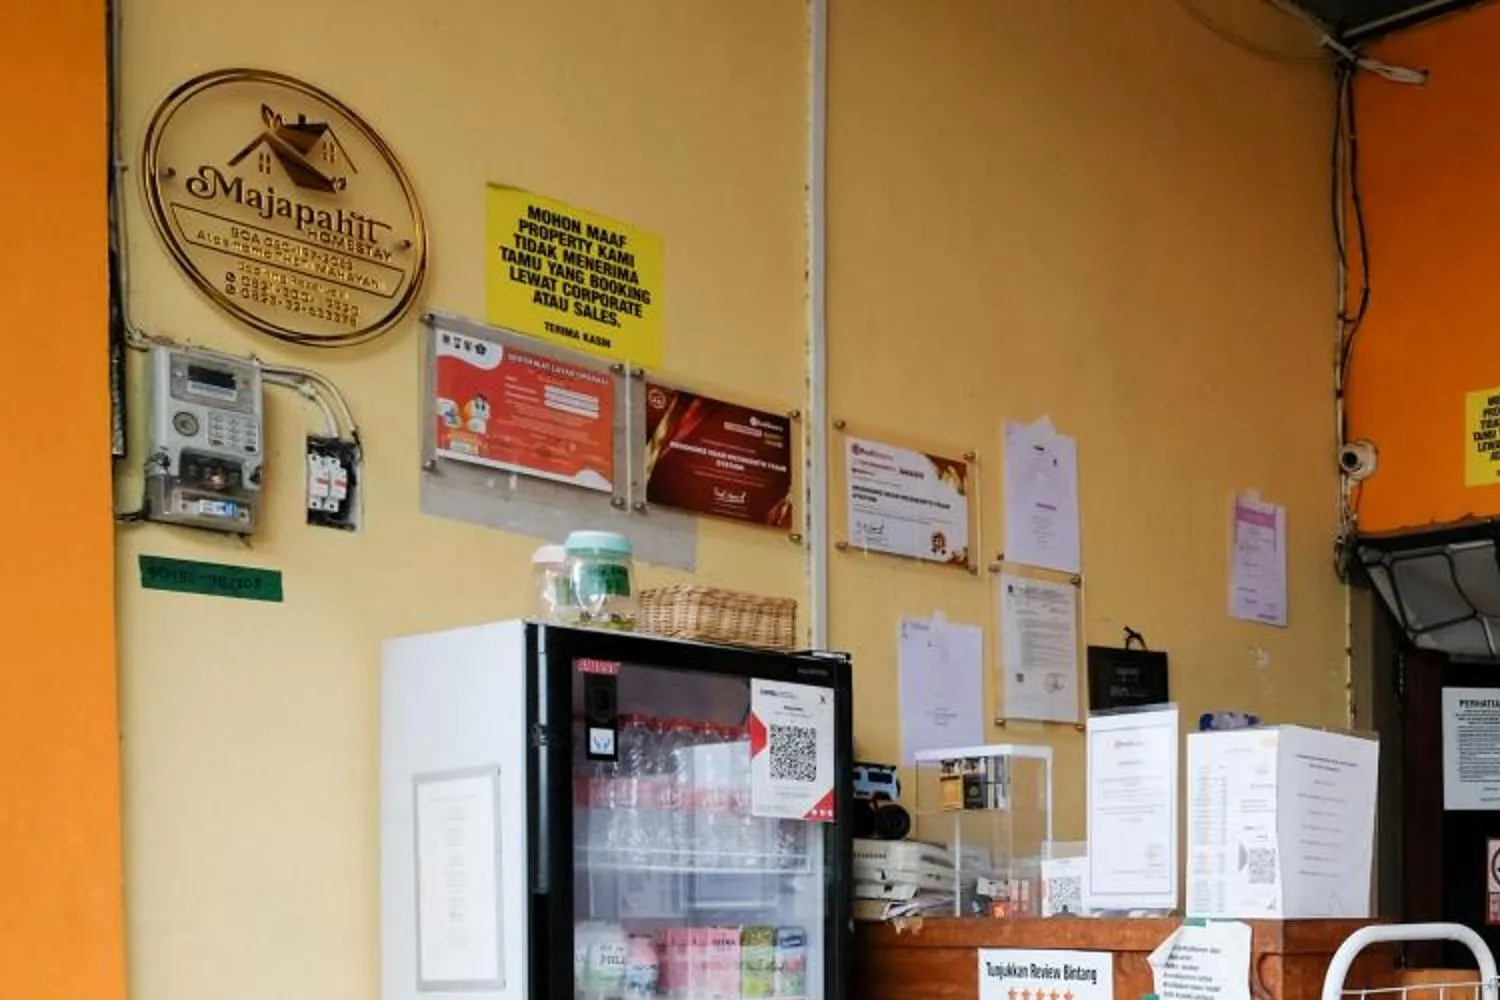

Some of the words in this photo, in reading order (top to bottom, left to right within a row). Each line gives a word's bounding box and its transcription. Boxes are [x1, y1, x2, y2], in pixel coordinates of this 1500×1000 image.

[186, 165, 392, 243] Majapahit
[528, 204, 581, 234] MOHON
[586, 224, 627, 248] MAAF
[307, 228, 393, 262] HOMESTAY
[513, 233, 557, 260] TIDAK
[563, 250, 639, 285] MENERIMA
[519, 218, 592, 252] PROPERTY
[598, 243, 635, 267] KAMI
[499, 246, 541, 271] TAMU
[548, 261, 584, 284] YANG
[590, 274, 651, 304] BOOKING
[510, 266, 557, 292] LEWAT
[562, 282, 642, 318] CORPORATE
[533, 290, 568, 312] ATAU
[574, 301, 621, 328] SALES.
[544, 322, 580, 339] TERIMA
[583, 332, 611, 348] KASIH
[986, 961, 1028, 980] Tunjukkan
[1030, 963, 1060, 979] Review
[1063, 964, 1097, 984] Bintang
